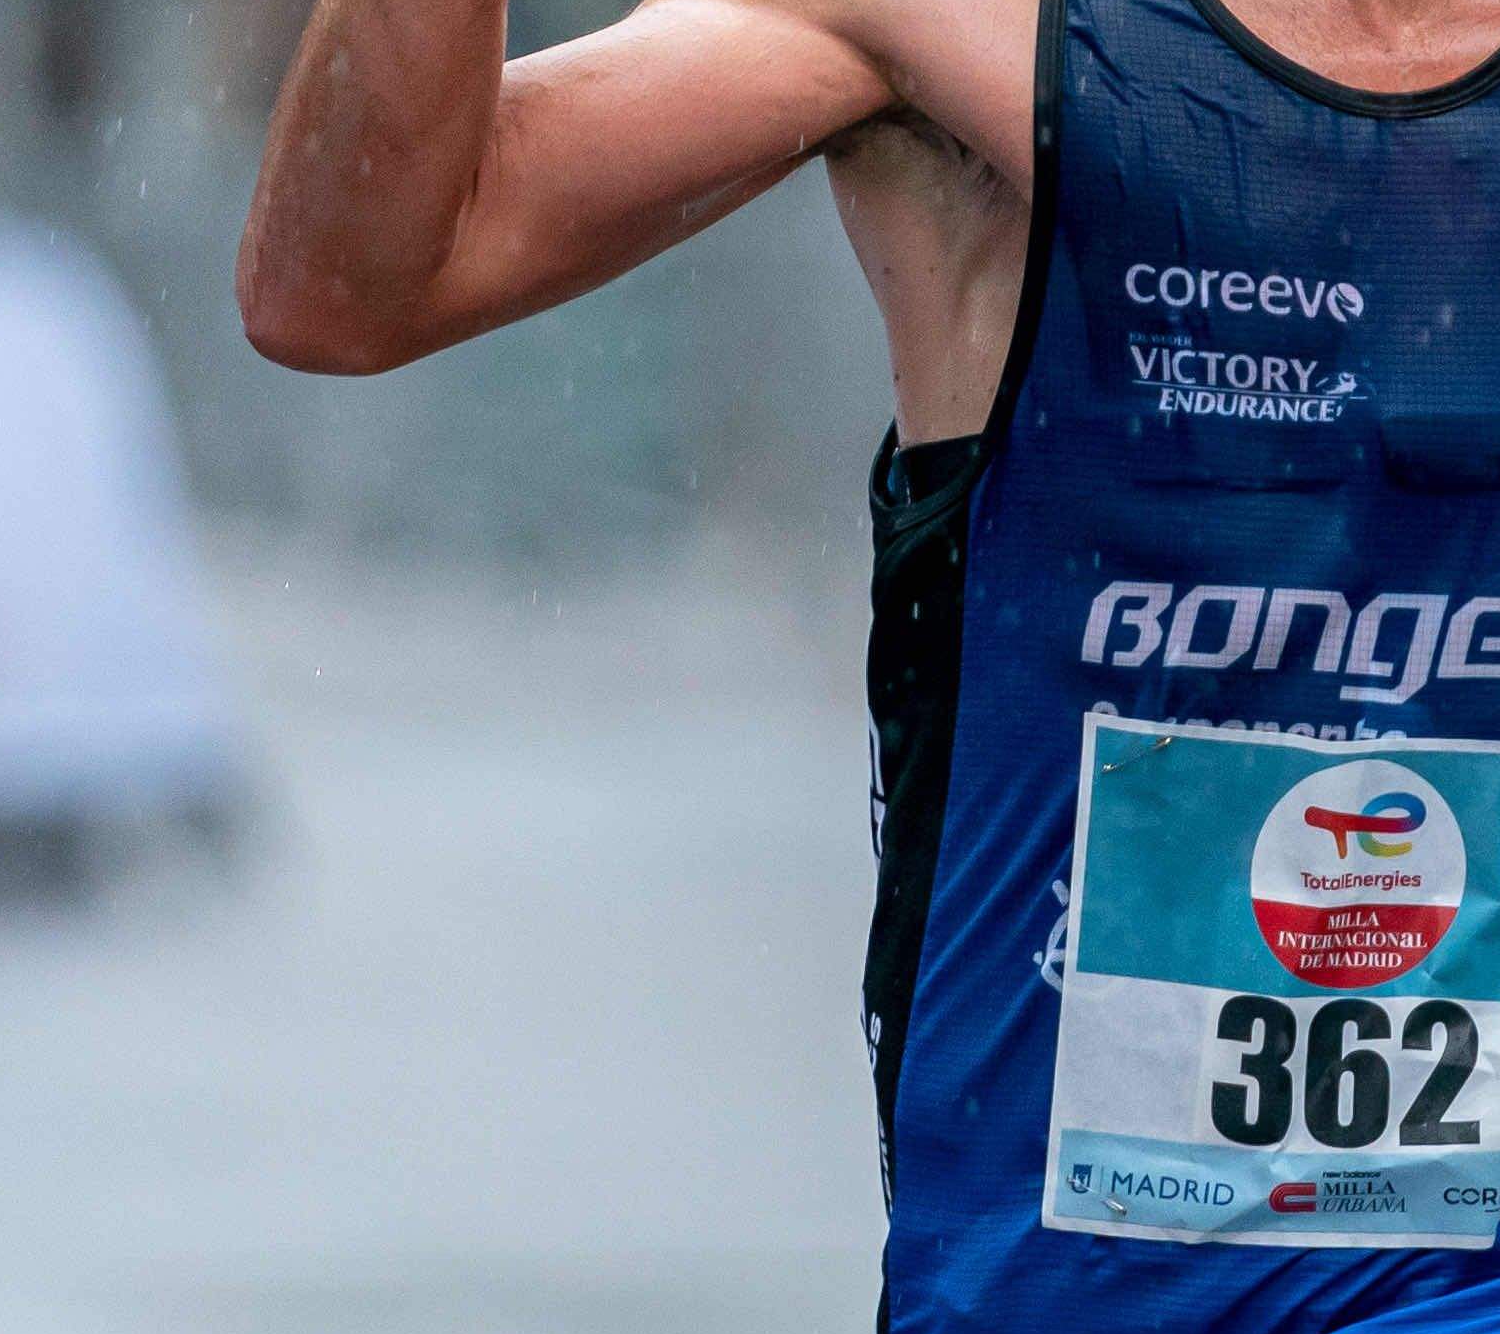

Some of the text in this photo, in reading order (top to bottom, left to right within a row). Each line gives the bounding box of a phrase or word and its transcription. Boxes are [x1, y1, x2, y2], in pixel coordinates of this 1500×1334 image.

[1125, 263, 1364, 323] coreevo
[1130, 344, 1319, 393] VICTORY
[1158, 387, 1337, 423] ENDURANCE
[1301, 870, 1421, 891] TotalEnergies
[1327, 911, 1380, 929] MILLA
[1300, 951, 1403, 969] DE MADRID
[1211, 994, 1481, 1149] 362
[1111, 1170, 1234, 1206] MADRID
[1323, 1180, 1396, 1197] MILLA
[1322, 1195, 1408, 1213] URBANA
